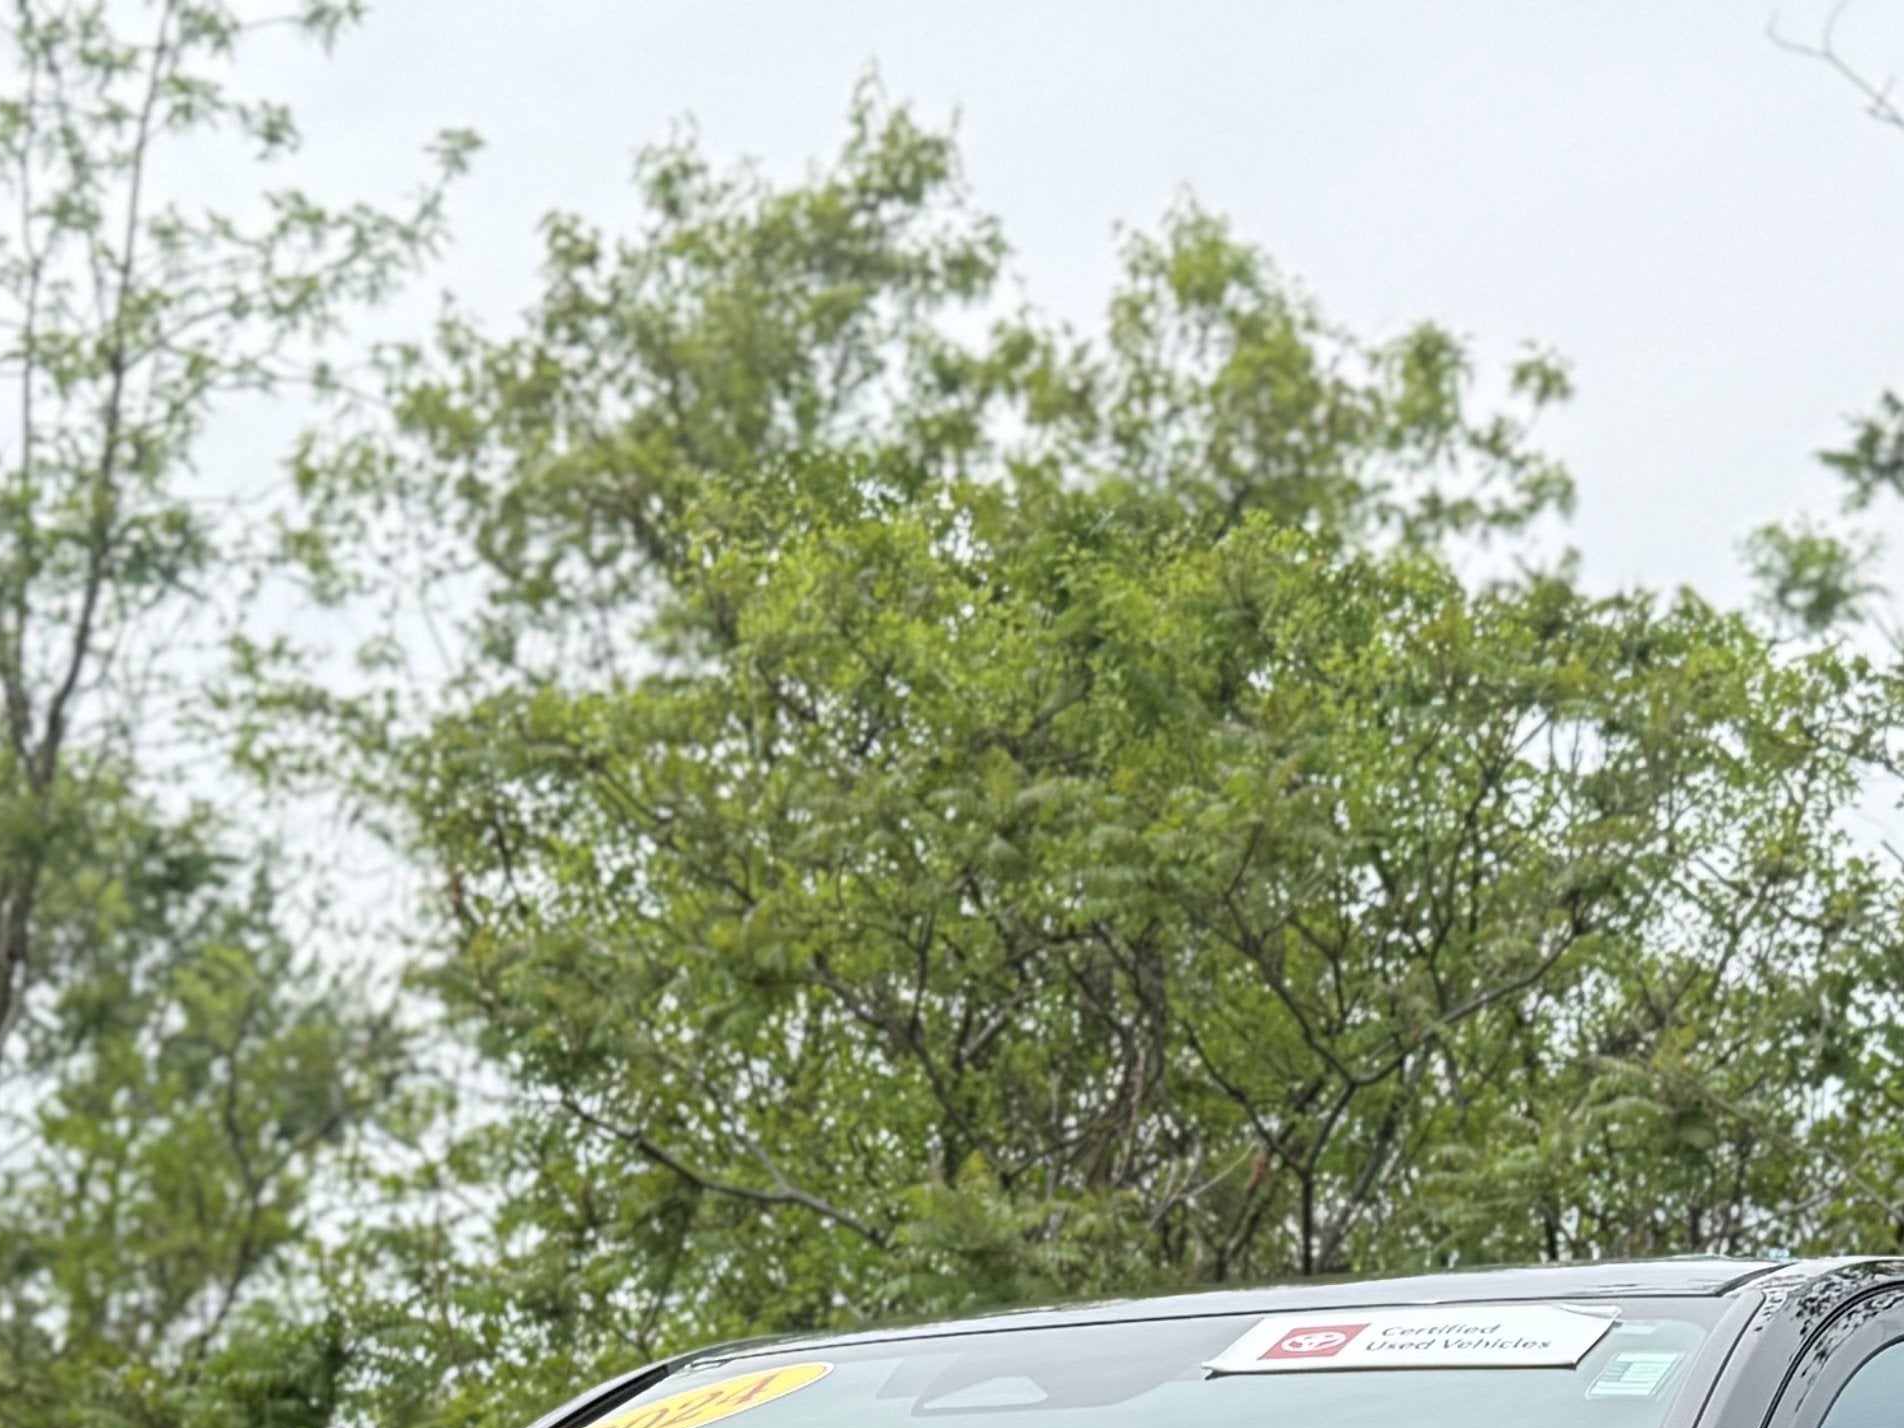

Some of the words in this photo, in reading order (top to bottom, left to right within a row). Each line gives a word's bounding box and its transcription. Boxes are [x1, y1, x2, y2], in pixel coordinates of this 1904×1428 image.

[1381, 1322, 1501, 1338] Certified
[1365, 1339, 1434, 1353] Used
[1441, 1337, 1553, 1353] Vehicles
